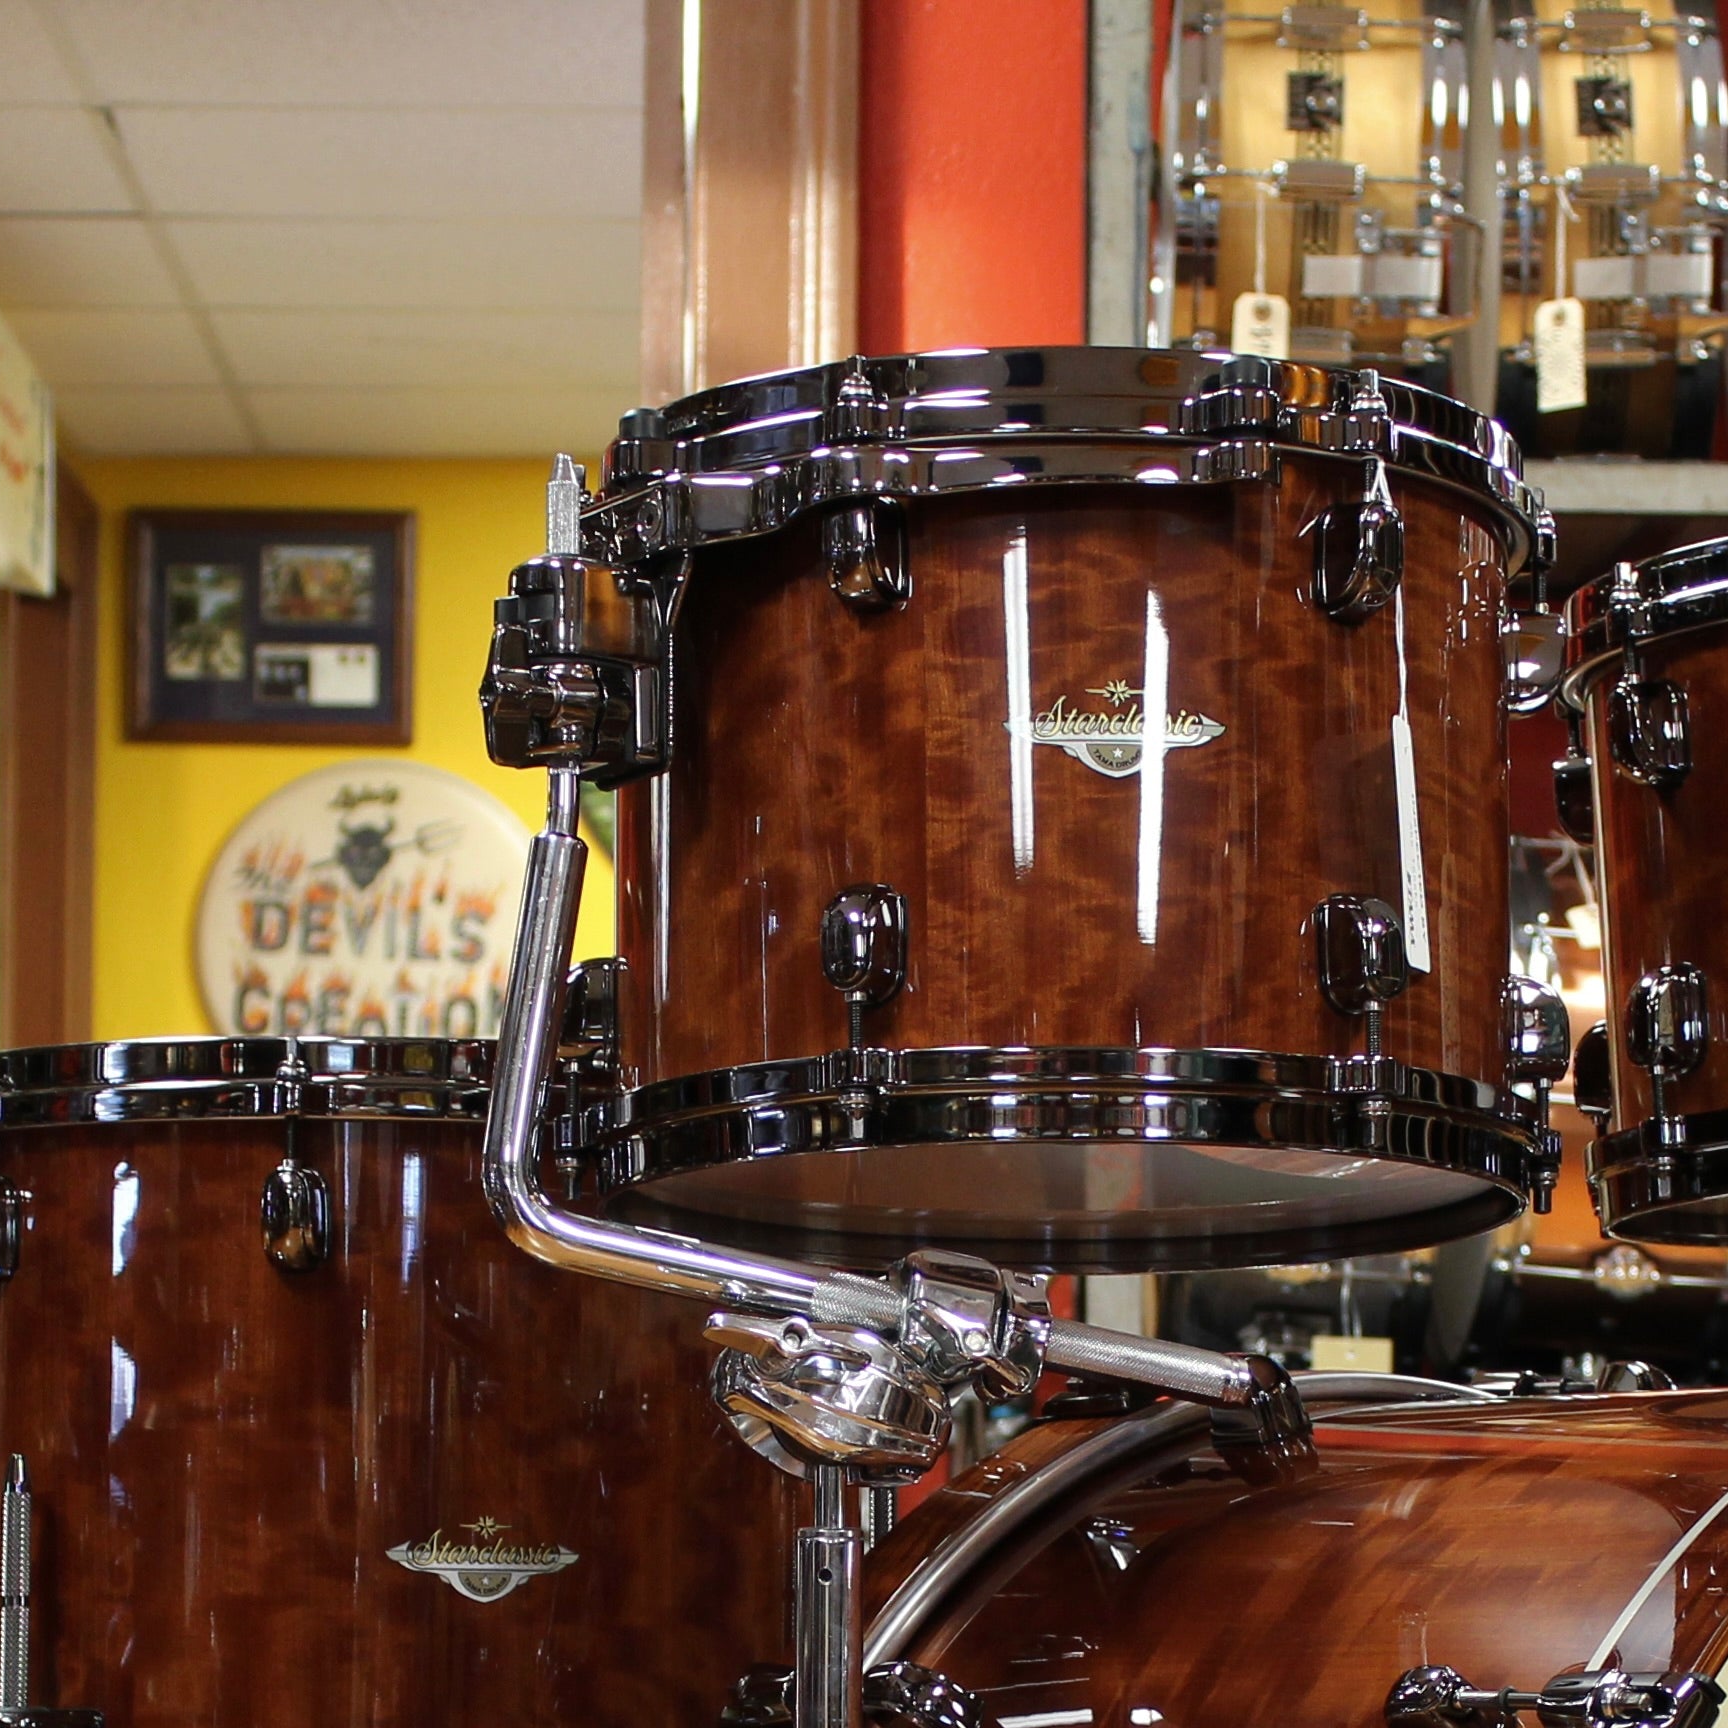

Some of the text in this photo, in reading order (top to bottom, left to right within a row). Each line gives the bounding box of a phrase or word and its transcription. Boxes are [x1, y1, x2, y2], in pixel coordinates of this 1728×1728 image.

[1034, 695, 1201, 738] Starclasic
[247, 880, 488, 965] DEVIL'S
[413, 1528, 556, 1566] Starclassic
